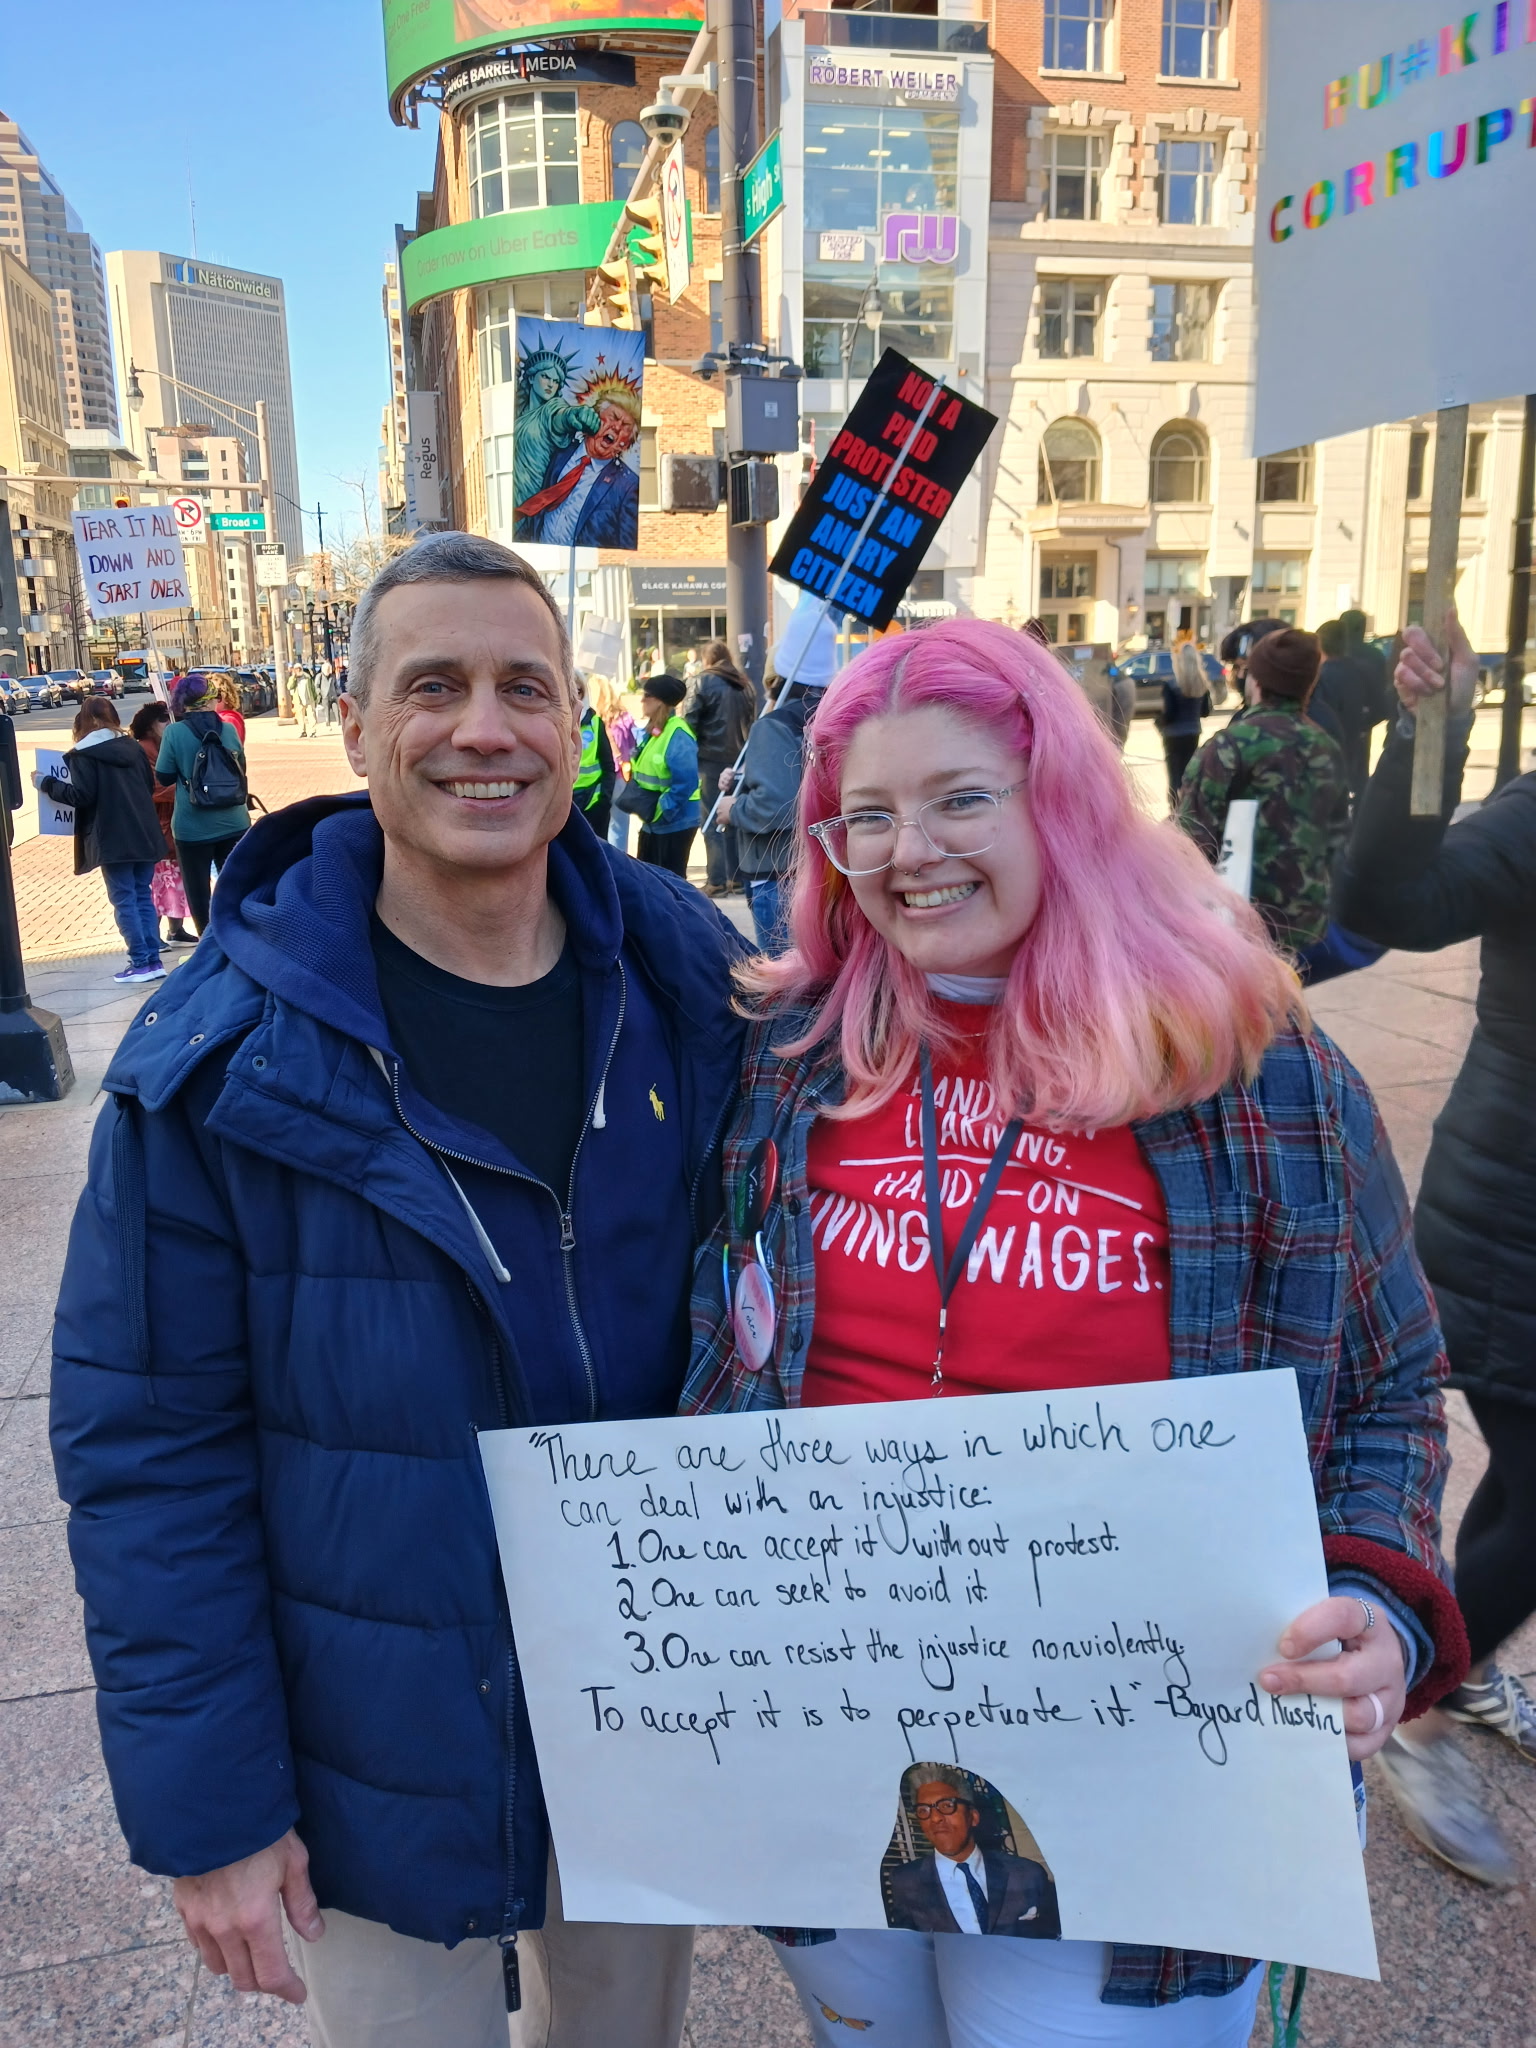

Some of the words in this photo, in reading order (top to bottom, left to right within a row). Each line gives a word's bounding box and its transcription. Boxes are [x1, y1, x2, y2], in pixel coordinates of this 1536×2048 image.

[470, 60, 518, 83] BARREL
[525, 56, 576, 71] MEDIA
[811, 66, 883, 87] ROBERT
[890, 70, 957, 90] WEILER
[1322, 0, 1536, 131] FU#KI
[746, 198, 752, 216] S
[752, 167, 773, 217] High
[417, 256, 439, 277] Order
[442, 250, 465, 267] now
[469, 244, 486, 261] on
[490, 237, 528, 257] Uber
[532, 230, 579, 250] Eats
[198, 269, 271, 298] Nationwide
[898, 371, 948, 418] NOT
[938, 398, 963, 431] A
[420, 437, 437, 479] Regus
[882, 411, 939, 463] PAID
[76, 516, 122, 542] TEAR
[123, 514, 146, 538] IT
[152, 514, 177, 538] ALL
[221, 516, 250, 527] Broad
[809, 513, 899, 578] ANGRY
[878, 505, 923, 548] AN
[89, 552, 134, 574] DOWN
[146, 548, 175, 568] AND
[789, 547, 883, 618] CITIZEN
[97, 581, 142, 604] START
[150, 579, 185, 599] OVER
[642, 582, 669, 590] BLACK
[671, 582, 709, 590] KAHAWA
[640, 616, 650, 628] 2
[904, 1110, 1071, 1170] LARNNG.
[809, 1189, 933, 1273] IVING
[966, 1221, 1164, 1293] WAGES.
[677, 1445, 745, 1472] are
[760, 1418, 851, 1472] three
[865, 1438, 948, 1492] ways
[963, 1431, 1002, 1457] in
[1023, 1402, 1130, 1452] which
[561, 1498, 621, 1527] can
[640, 1481, 700, 1520] deal
[725, 1475, 788, 1514] with
[809, 1489, 843, 1510] an
[704, 1538, 747, 1559] can
[764, 1524, 843, 1585] accept
[855, 1524, 878, 1556] it
[1028, 1520, 1120, 1608] protest.
[716, 1588, 760, 1607] can
[776, 1573, 830, 1604] seek
[844, 1569, 867, 1600] to
[889, 1565, 951, 1603] avoid
[965, 1569, 989, 1605] it.
[729, 1650, 771, 1667] can
[785, 1629, 856, 1665] resist
[866, 1628, 904, 1663] the
[918, 1624, 1011, 1692] injustice
[1032, 1620, 1191, 1689] nonviolently.
[580, 1686, 624, 1732] To
[641, 1690, 736, 1765] accept
[753, 1689, 781, 1728] it
[802, 1701, 823, 1727] is
[840, 1688, 871, 1722] to
[897, 1684, 1083, 1763] perpetuate
[1270, 1693, 1342, 1736] Rustin
